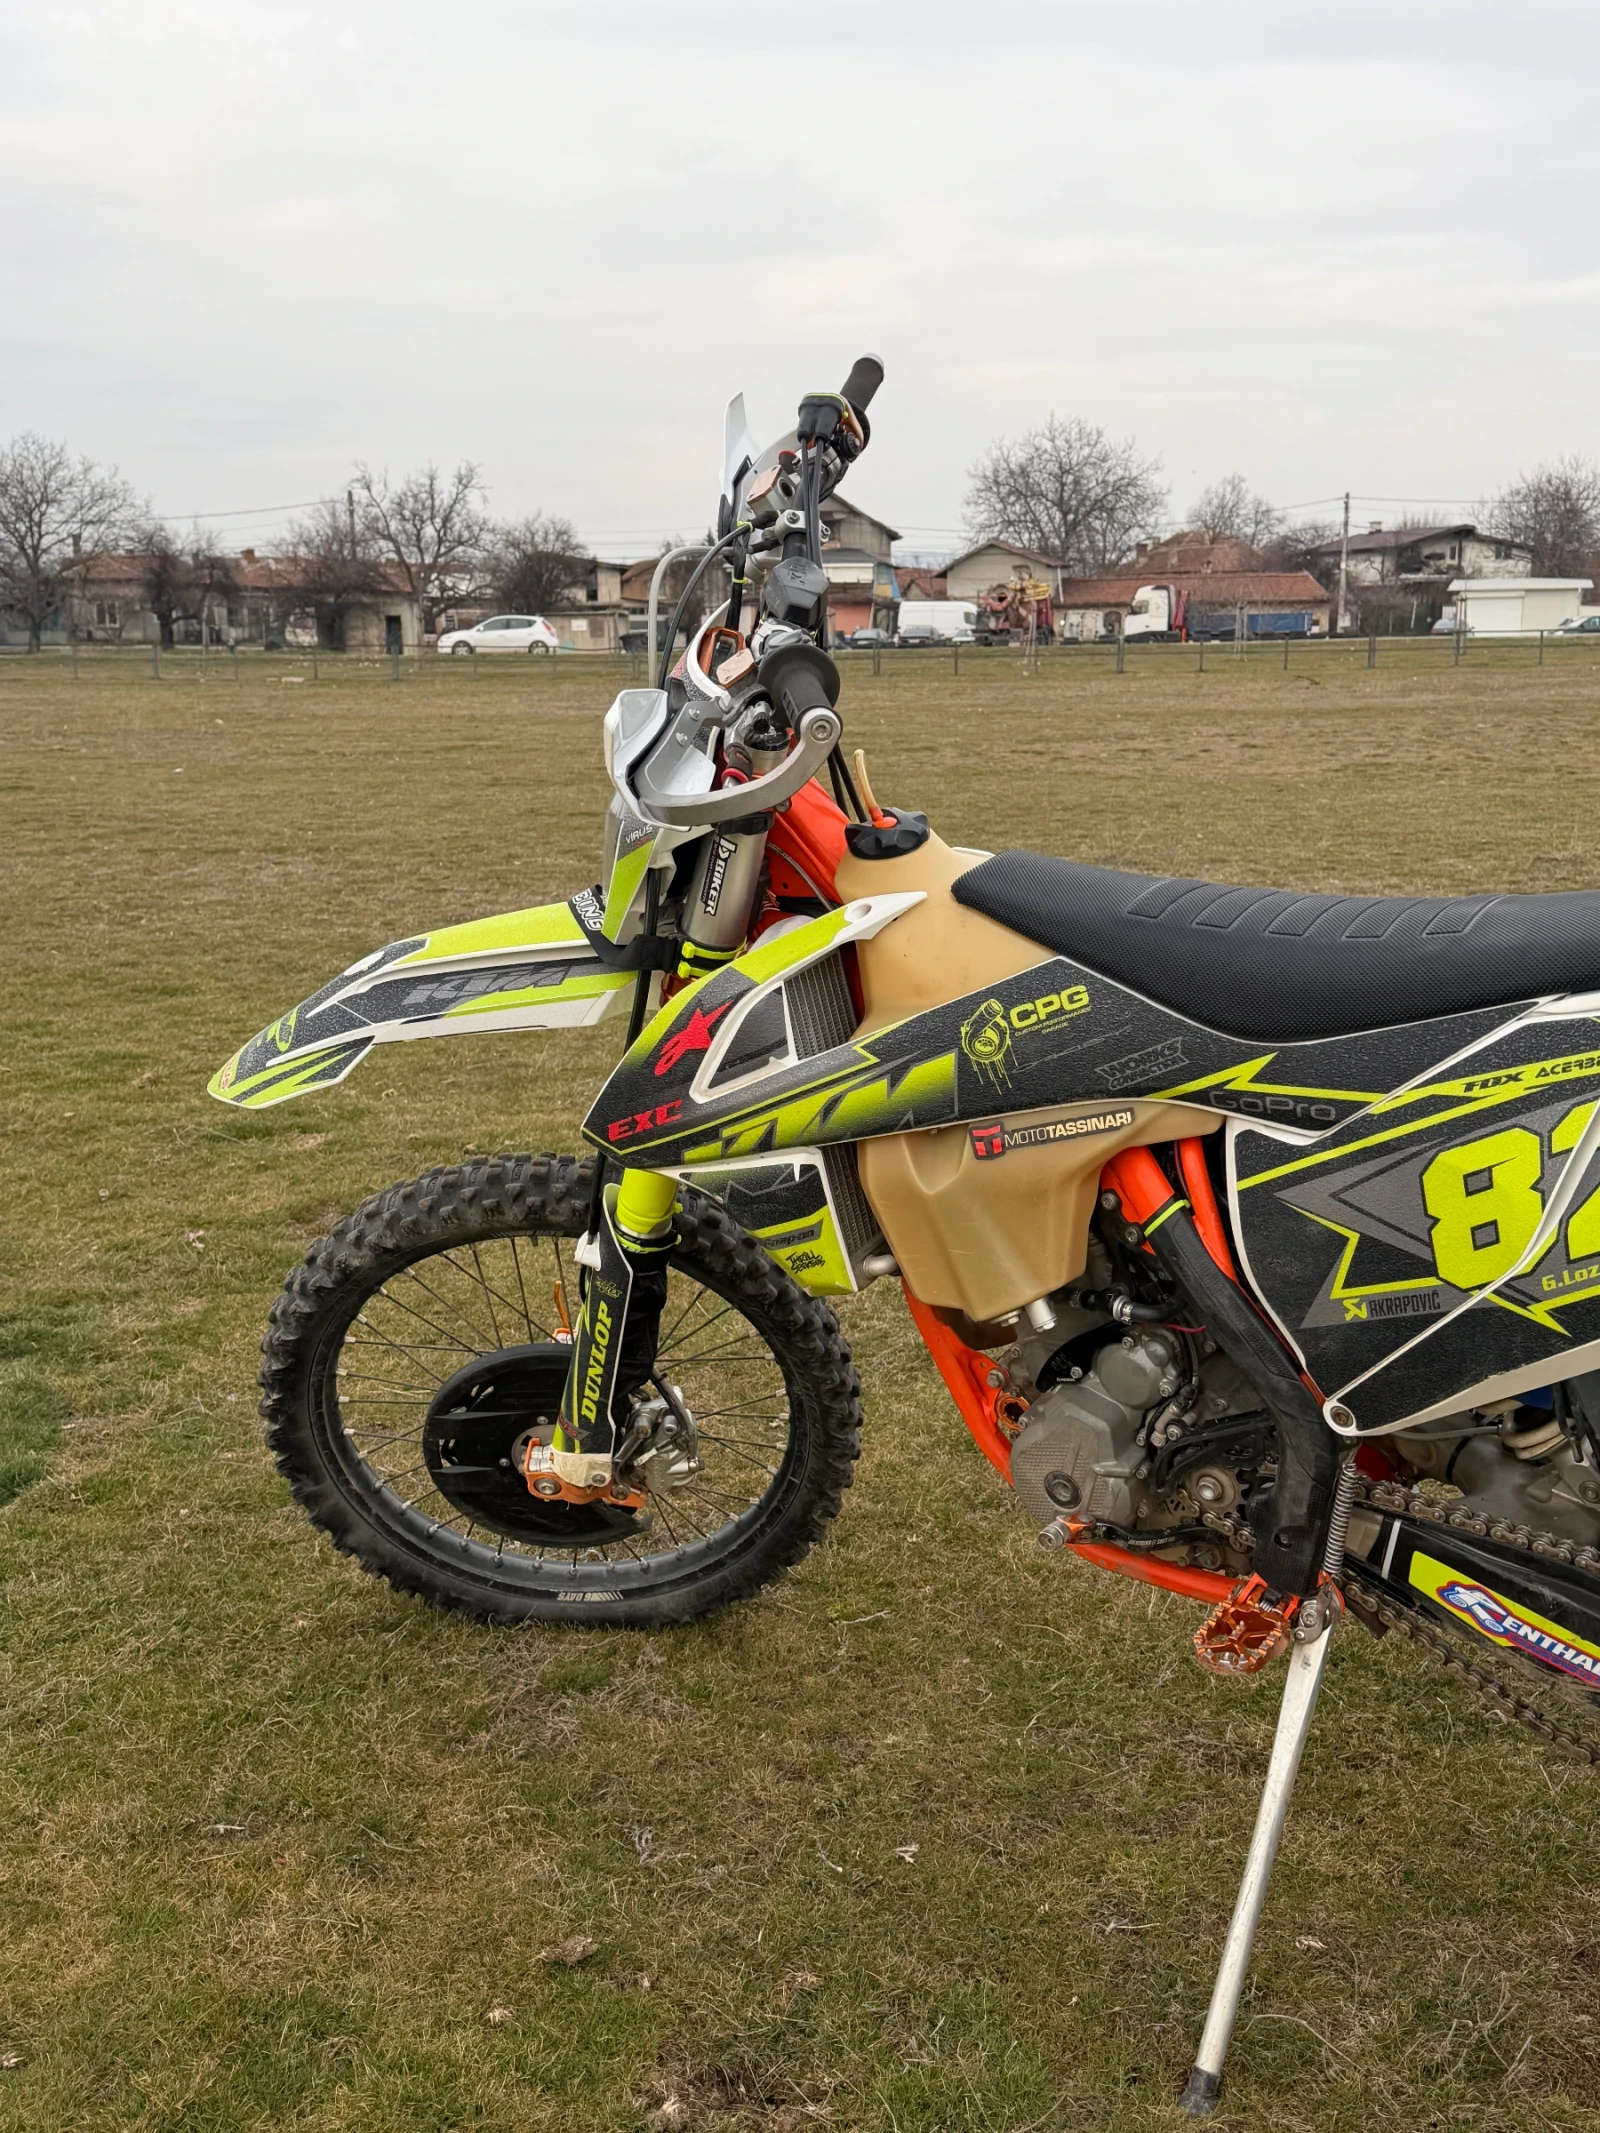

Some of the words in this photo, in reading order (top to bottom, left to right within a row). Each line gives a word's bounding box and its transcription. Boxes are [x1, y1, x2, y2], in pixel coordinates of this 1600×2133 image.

[624, 823, 653, 844] VIRUS
[1009, 985, 1090, 1029] CPG
[1461, 1070, 1526, 1093] FOX
[607, 1098, 683, 1142] EXC
[1209, 1090, 1336, 1121] GoPro
[581, 1301, 612, 1424] DUNLOP
[556, 1592, 584, 1602] DAYS
